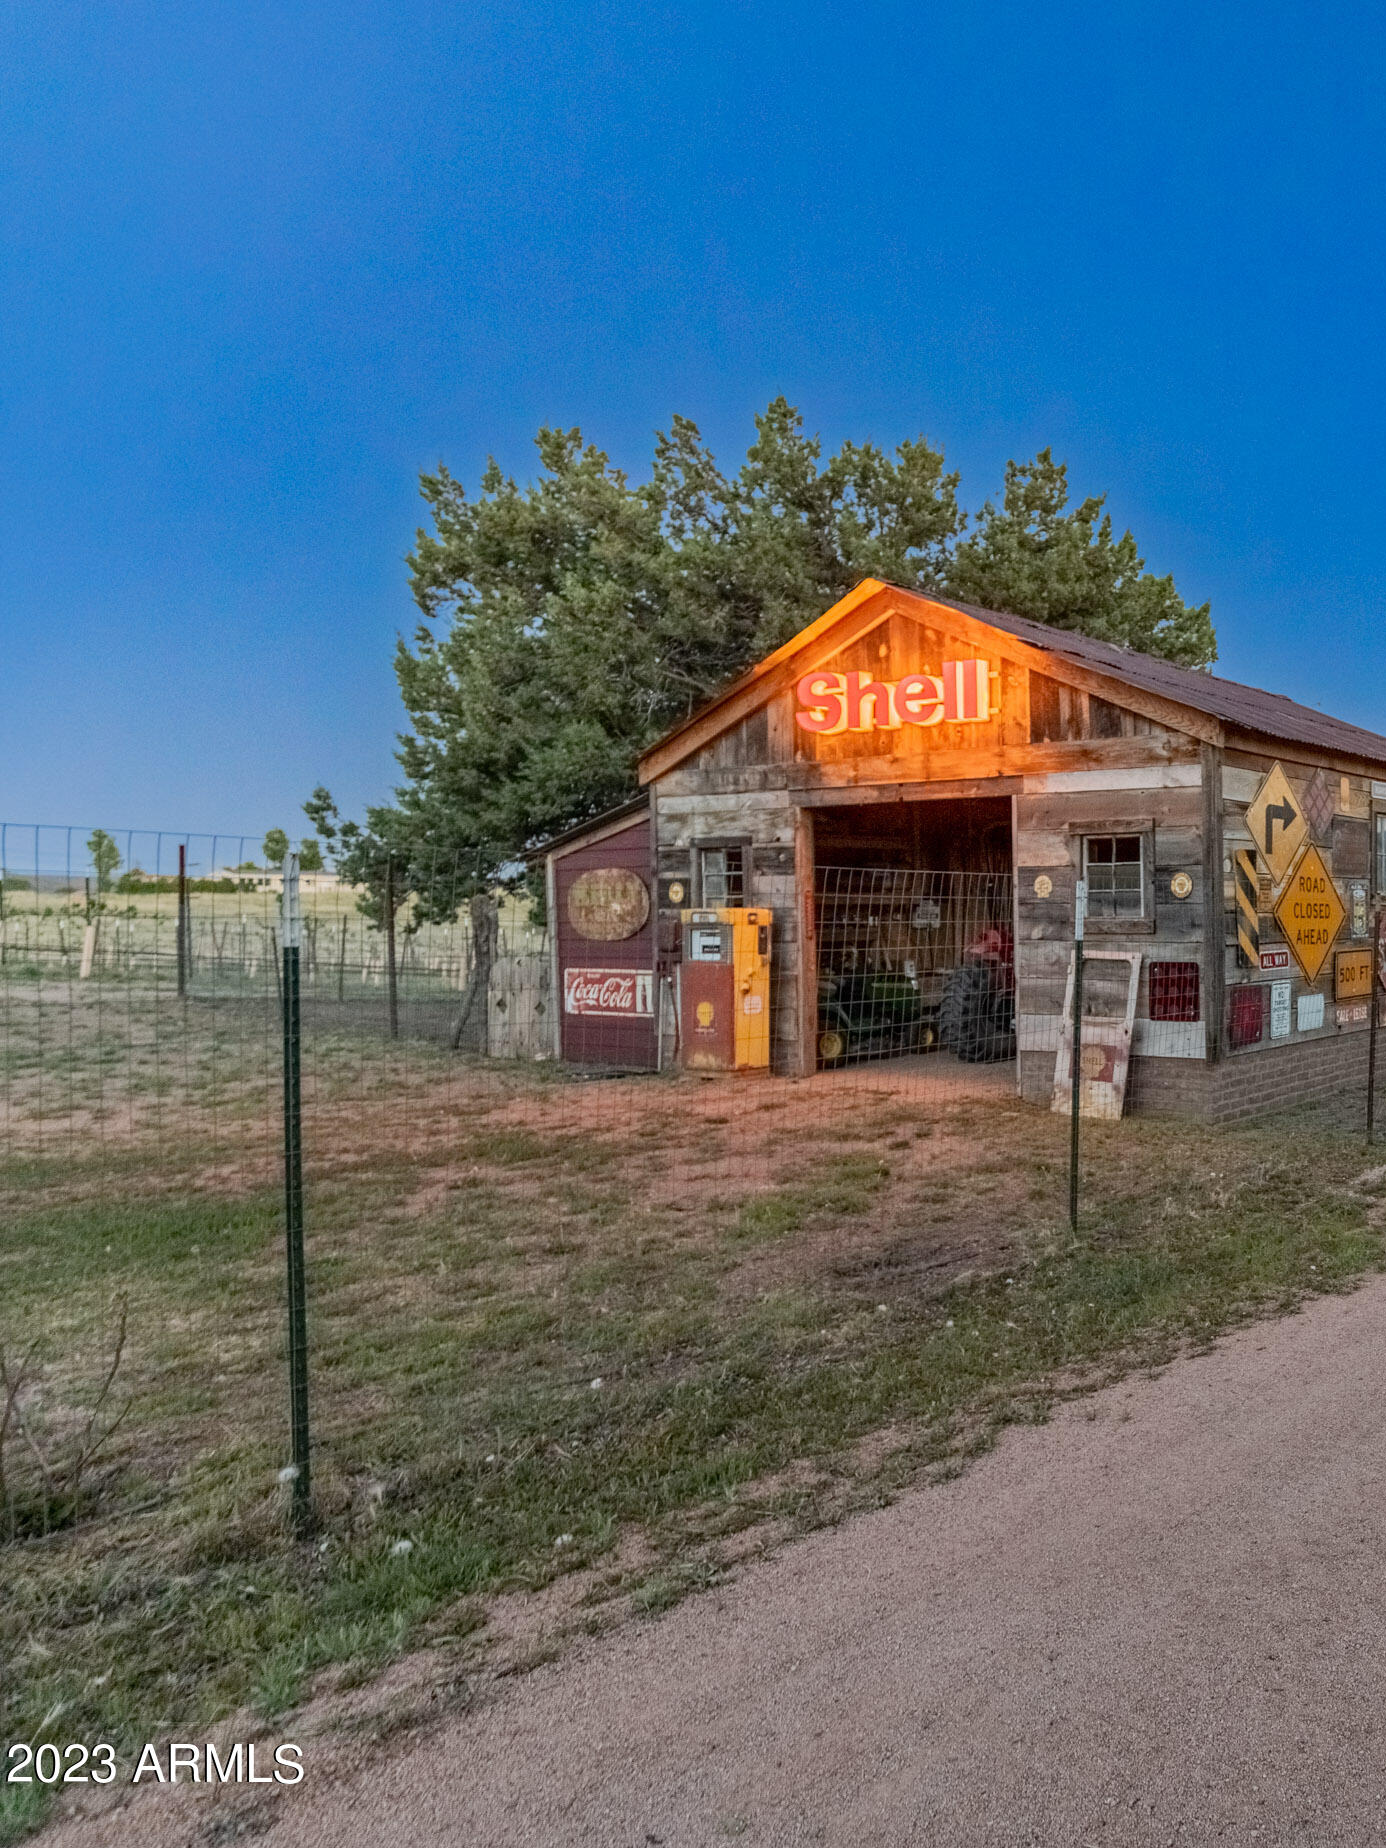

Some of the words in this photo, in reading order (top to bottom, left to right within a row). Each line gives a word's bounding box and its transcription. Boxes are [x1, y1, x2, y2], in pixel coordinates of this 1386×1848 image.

[796, 659, 990, 734] Shell
[1300, 876, 1325, 893] ROAD
[1293, 902, 1331, 919] CLOSED
[1296, 929, 1328, 945] AHEAD
[1263, 956, 1273, 967] ALL
[1275, 954, 1288, 966] WAY
[1340, 967, 1355, 983] 500
[1360, 966, 1369, 980] FT
[567, 976, 633, 1009] Coca-Cola
